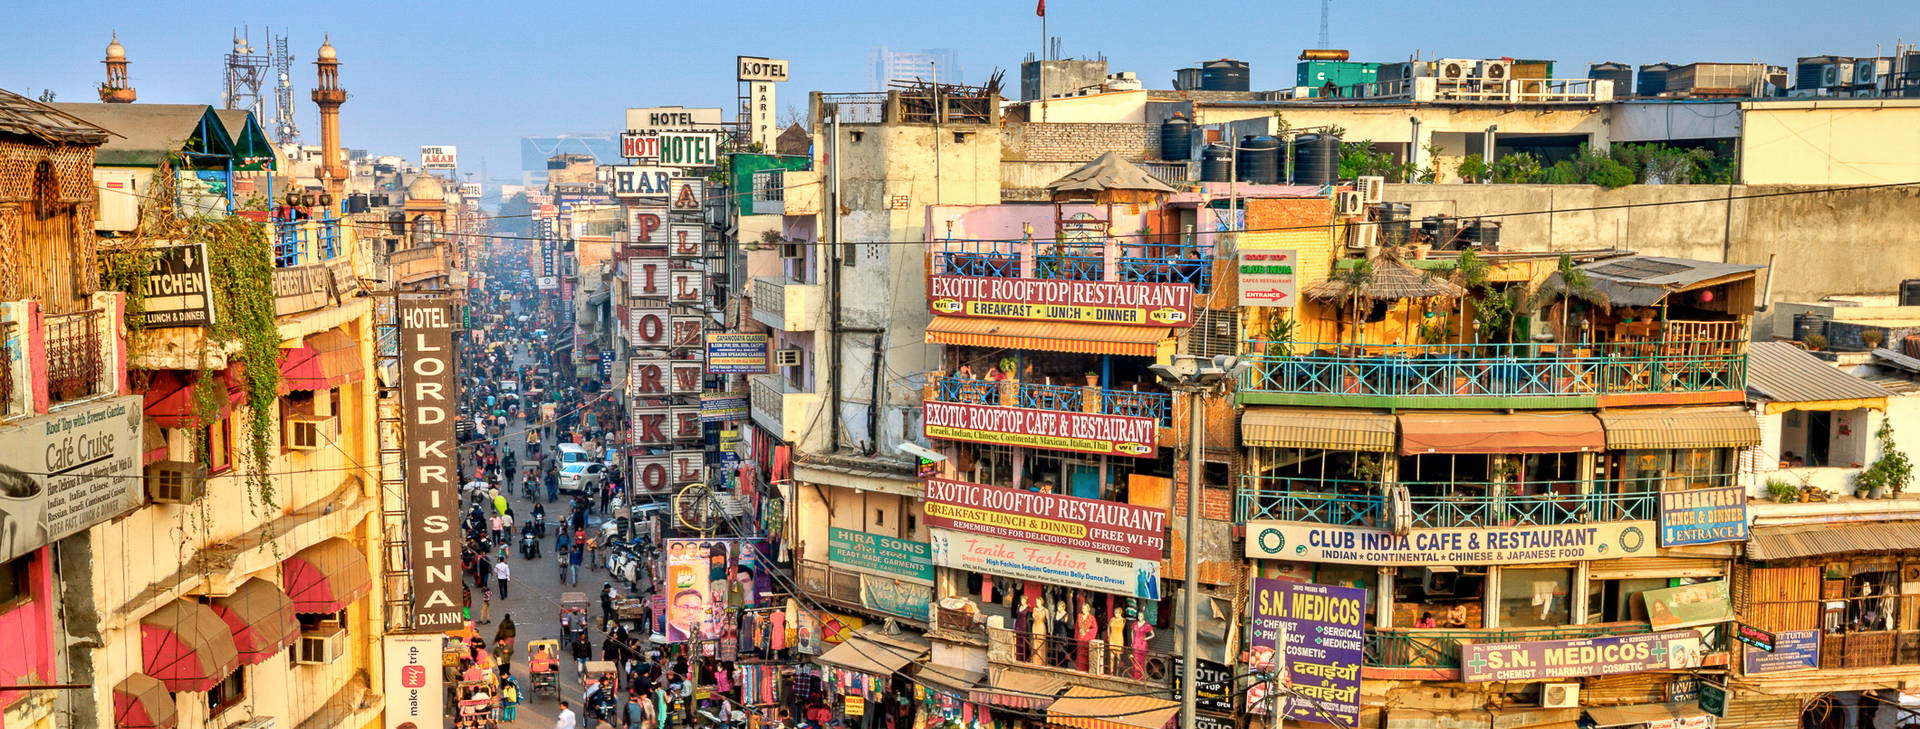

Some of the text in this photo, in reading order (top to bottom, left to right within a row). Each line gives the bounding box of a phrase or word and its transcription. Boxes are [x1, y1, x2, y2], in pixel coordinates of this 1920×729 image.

[651, 113, 695, 126] HOTEL
[624, 138, 659, 156] HOT
[660, 135, 714, 164] HOTEL
[617, 171, 681, 194] HAR
[1240, 264, 1293, 275] CLUB INDIA
[932, 277, 1189, 306] EXOTIC ROOFTOP RESTAURANT
[147, 311, 206, 323] LUNCH & DINNER
[404, 307, 449, 328] HOTEL
[974, 302, 1032, 317] BREAKFAST
[1046, 306, 1081, 319] LUNCH
[1096, 308, 1137, 322] DINNER
[46, 404, 125, 435] Roof Top with Garden
[926, 403, 1152, 443] EXOTIC ROOFTOP CAFE & RESTAURANT
[930, 426, 950, 436] Israeli,
[952, 428, 973, 439] Indian,
[974, 431, 999, 441] Chinese,
[1000, 433, 1039, 445] Continental,
[1093, 441, 1108, 450] Thai
[46, 430, 114, 472] Café Cruise
[413, 333, 455, 608] LORD KRISHNA
[111, 486, 126, 498] Cuisine
[1664, 489, 1743, 511] BREAKFAST
[927, 480, 1165, 533] EXOTIC ROOFTOP RESTAURANT
[1665, 505, 1744, 527] LUNCH & DINNER
[927, 503, 1164, 550] BREAKFAST LUNCH & DINNER (FREE WI-FI)
[953, 521, 1130, 554] REMEMBER US FOR DELICIOUS FOOD SERVICES
[1675, 526, 1735, 541] ENTRANCE
[837, 530, 925, 554] HIRA SONS
[1309, 529, 1355, 549] CLUB
[1361, 532, 1411, 551] INDIA
[1416, 533, 1462, 551] CAFE
[1468, 532, 1481, 549] &
[1486, 527, 1598, 549] RESTAURANT
[837, 549, 925, 571] READY MADE GARMENTS
[964, 539, 1016, 560] Tanika
[1023, 547, 1087, 570] Fashion
[1322, 548, 1585, 562] INDIAN CONTINENTAL CHINESE & JAPANESE FOOD
[986, 558, 1000, 566] High
[1000, 560, 1021, 569] Fashion
[1042, 566, 1070, 577] Garments
[1070, 570, 1085, 580] Belly
[1085, 573, 1103, 582] Dance
[1104, 575, 1125, 585] Dresses
[1259, 589, 1360, 626] S.N. MEDICOS
[419, 612, 462, 626] DX.INN
[1263, 619, 1298, 632] CHEMIST
[1262, 630, 1306, 644] PHAMACY
[1322, 637, 1361, 651] MEDICINE
[1323, 626, 1362, 640] SERGICAL
[1786, 631, 1813, 640] TUITION
[1286, 645, 1327, 659] COSMETIC
[1487, 650, 1537, 669] S.N.
[1544, 642, 1649, 666] MEDICOS
[408, 647, 424, 716] make my trip
[1175, 665, 1230, 682] EOTIC
[1293, 661, 1360, 681] दवाईयाँ
[1496, 669, 1536, 679] CHEMIST
[1545, 666, 1593, 677] PHARMACY
[1602, 662, 1643, 673] COSMETIC
